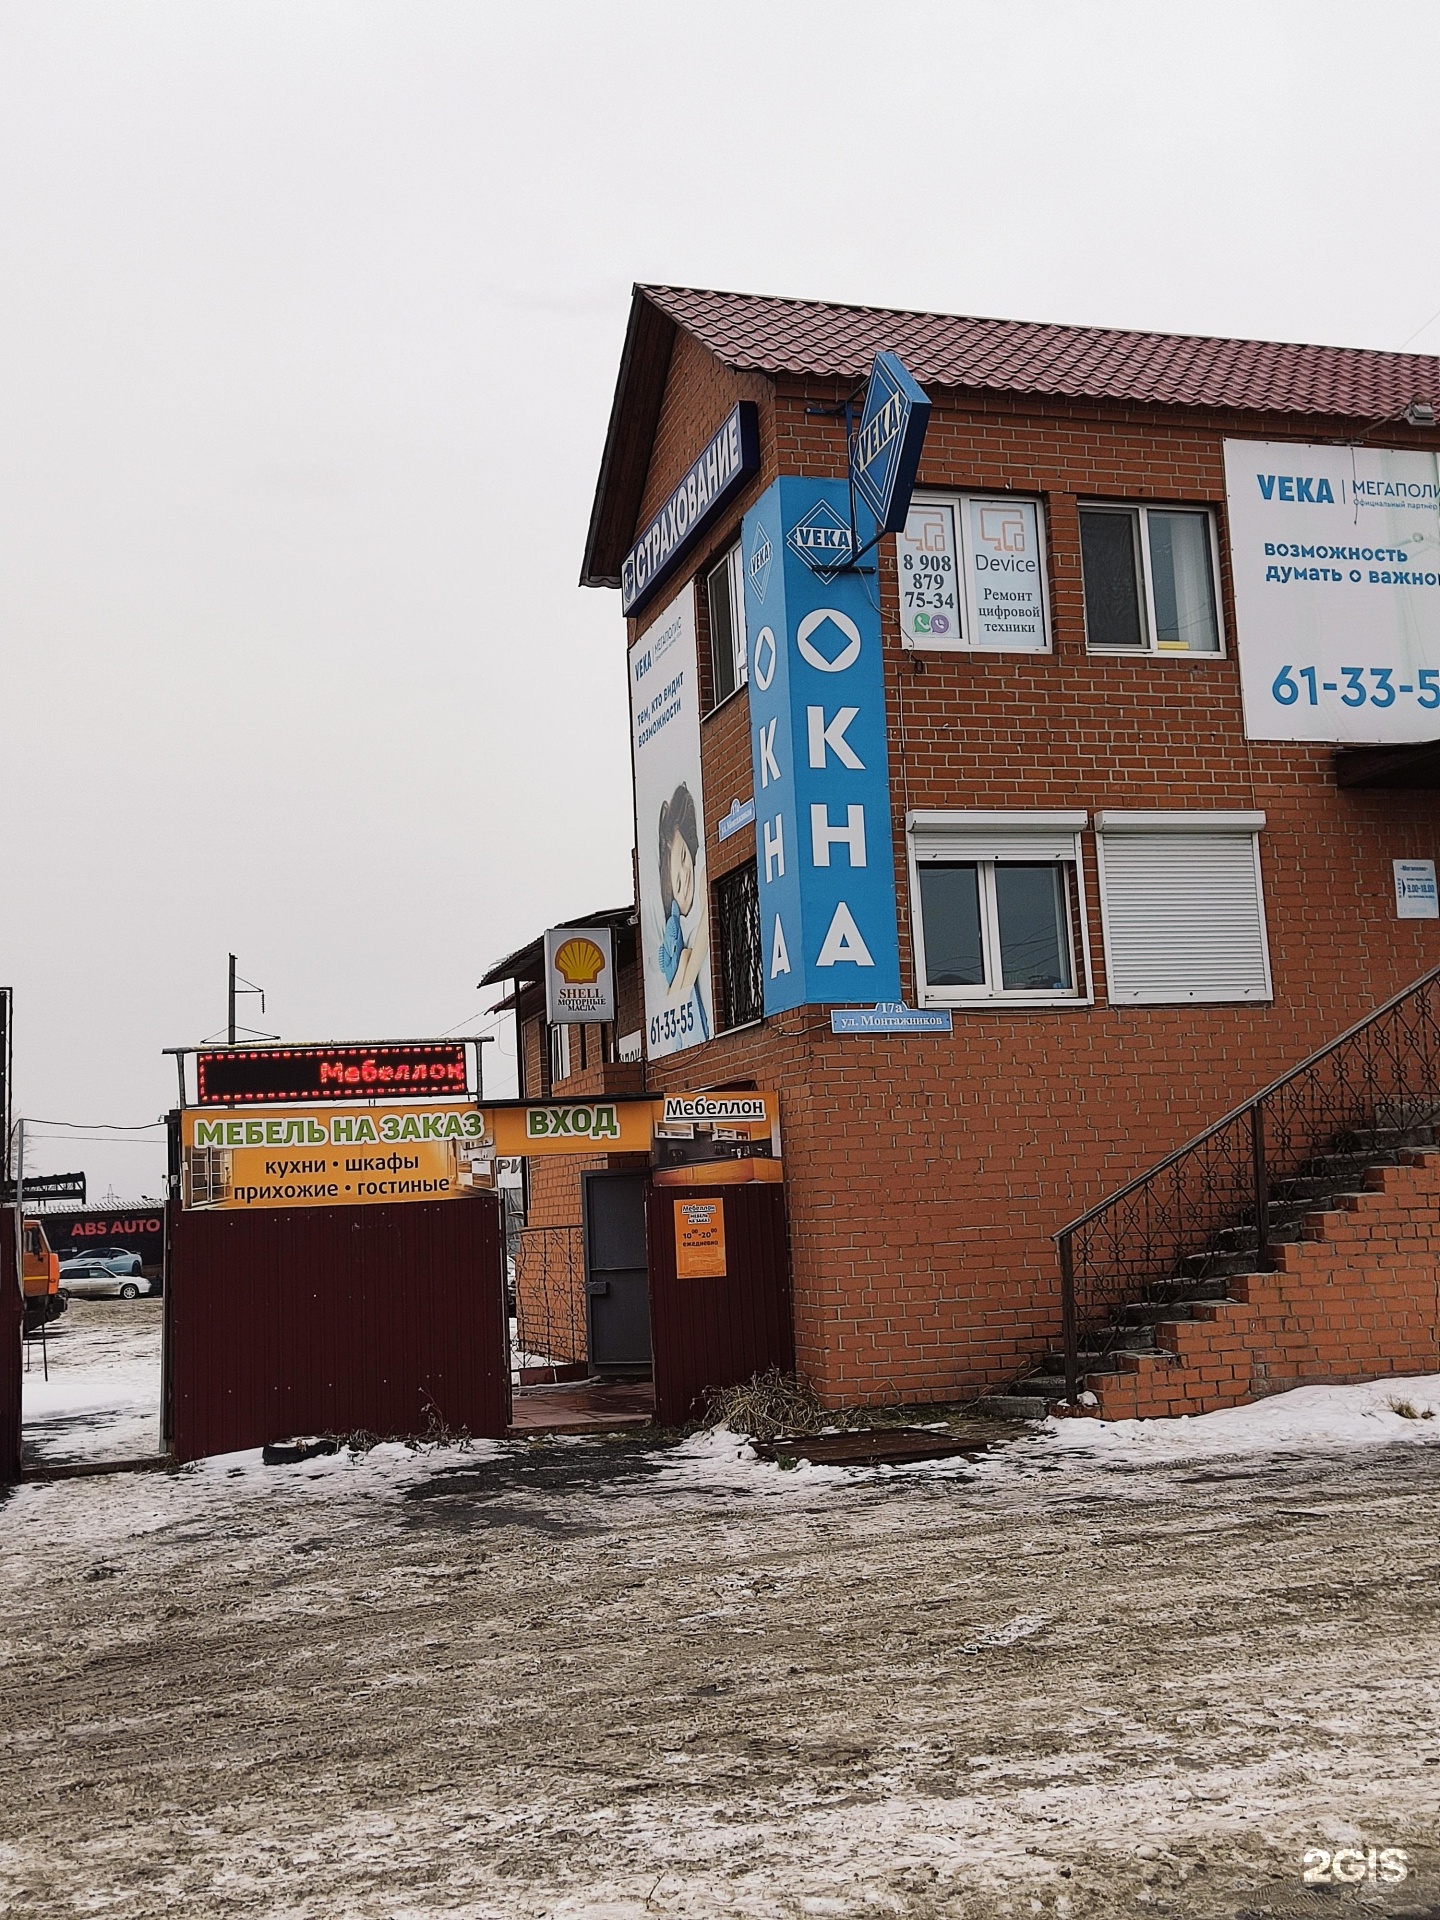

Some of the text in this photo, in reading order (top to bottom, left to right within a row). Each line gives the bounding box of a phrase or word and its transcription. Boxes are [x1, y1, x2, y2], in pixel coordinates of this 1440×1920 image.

[859, 396, 899, 470] VEKA
[1256, 473, 1335, 504] VEKA
[636, 414, 740, 589] СТРАХОВАНИЕ
[1353, 498, 1438, 511] Официальный партнёр
[799, 527, 851, 548] VEKA
[751, 542, 771, 574] VEKA
[1264, 541, 1408, 563] возможность
[903, 553, 952, 572] 8 908
[975, 553, 1036, 573] Device
[912, 572, 945, 591] 879
[1265, 565, 1440, 588] думать о важно
[904, 591, 955, 609] 75-34
[983, 587, 1033, 602] Ремонт
[979, 604, 1040, 620] цифровой
[984, 622, 1036, 633] техники
[634, 649, 652, 682] VEKA
[557, 998, 606, 1006] МОТОРНЫЕ
[559, 988, 604, 999] SHELL
[880, 1002, 904, 1014] 17а
[650, 1000, 695, 1046] 61-33-55
[841, 1015, 943, 1029] ул. Монтажников
[665, 1097, 764, 1116] Мебеллон
[196, 1112, 484, 1147] МЕБЕЛЬ НА ЗАКАЗ
[529, 1107, 618, 1137] ВХОД
[264, 1152, 420, 1179] кухни шкафы
[233, 1176, 451, 1204] прихожие гостиные
[71, 1218, 161, 1237] ABS AUTO
